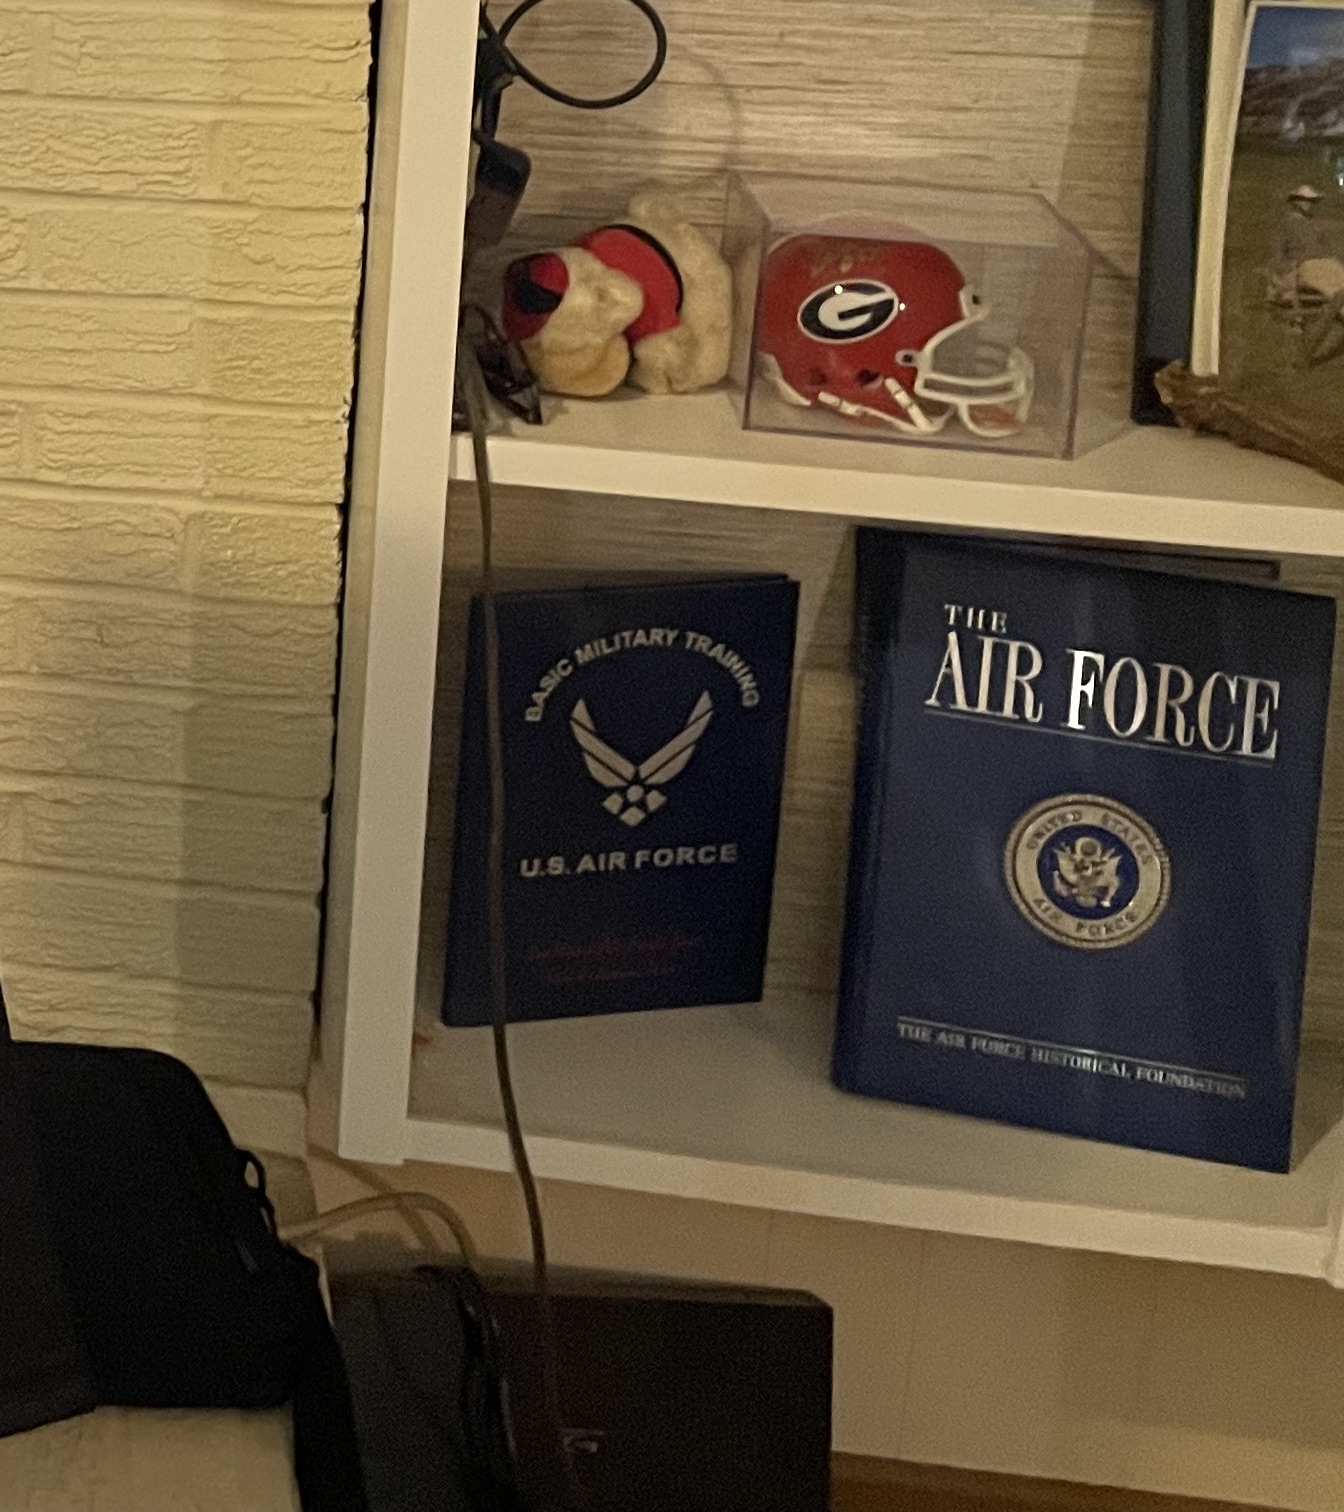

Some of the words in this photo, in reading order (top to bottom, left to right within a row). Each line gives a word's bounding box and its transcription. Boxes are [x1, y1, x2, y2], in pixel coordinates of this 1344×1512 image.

[943, 603, 1008, 635] THE
[524, 658, 573, 722] BASIC
[574, 627, 680, 666] MILITARY
[683, 630, 760, 708] TRAINING
[923, 630, 1044, 725] AIR
[1059, 648, 1281, 760] FORCE
[519, 855, 572, 878] U.S.
[574, 851, 627, 874] AIR
[634, 843, 738, 870] FORCE
[896, 1020, 932, 1045] THE
[935, 1027, 966, 1050] AIR
[970, 1033, 1027, 1061] FORCE
[1030, 1045, 1132, 1079] HISTORICAL
[1134, 1064, 1247, 1100] FOUNDATION
